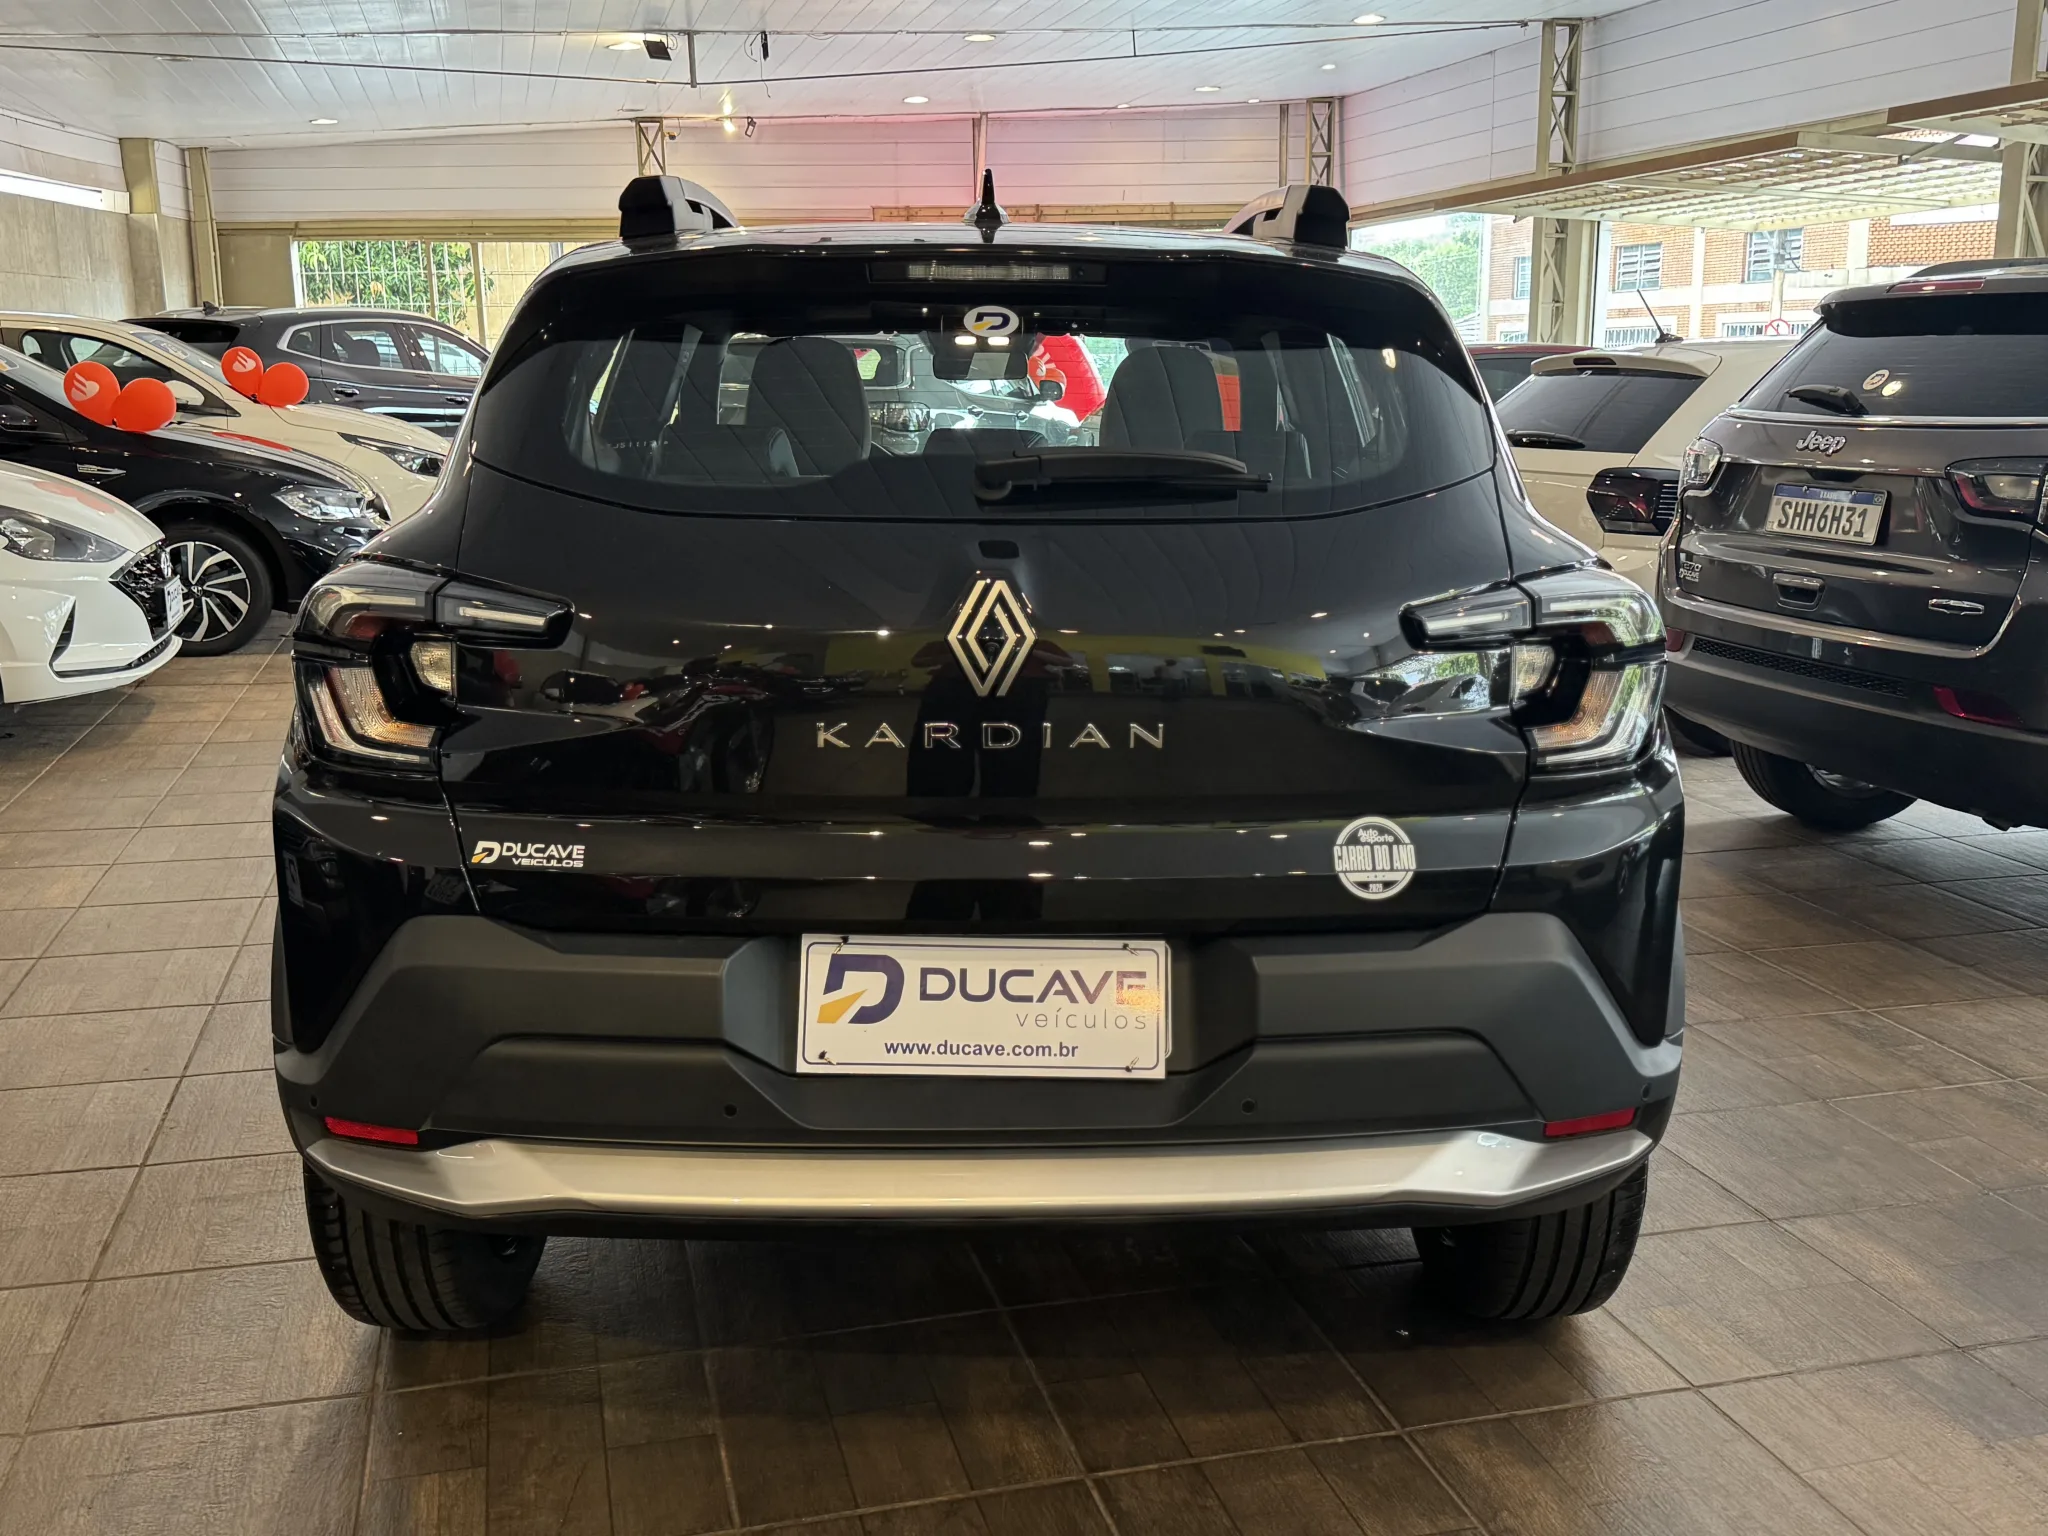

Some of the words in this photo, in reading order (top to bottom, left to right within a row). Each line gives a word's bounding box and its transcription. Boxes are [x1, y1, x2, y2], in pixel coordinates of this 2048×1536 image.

[1796, 431, 1846, 456] Jeep
[1777, 500, 1868, 538] SHH6H31
[816, 721, 1164, 749] KARDIAN
[1357, 828, 1379, 838] Auto
[1360, 834, 1395, 844] esporte
[502, 842, 586, 859] DUCAVE
[1333, 845, 1373, 872] CARRO
[1374, 844, 1391, 871] DO
[1393, 844, 1417, 870] ANO
[512, 857, 584, 868] VEICULOS
[919, 967, 1148, 1006] DUCAVE
[1016, 1008, 1148, 1031] veículos
[884, 1040, 1079, 1059] www.ducave.com.br
